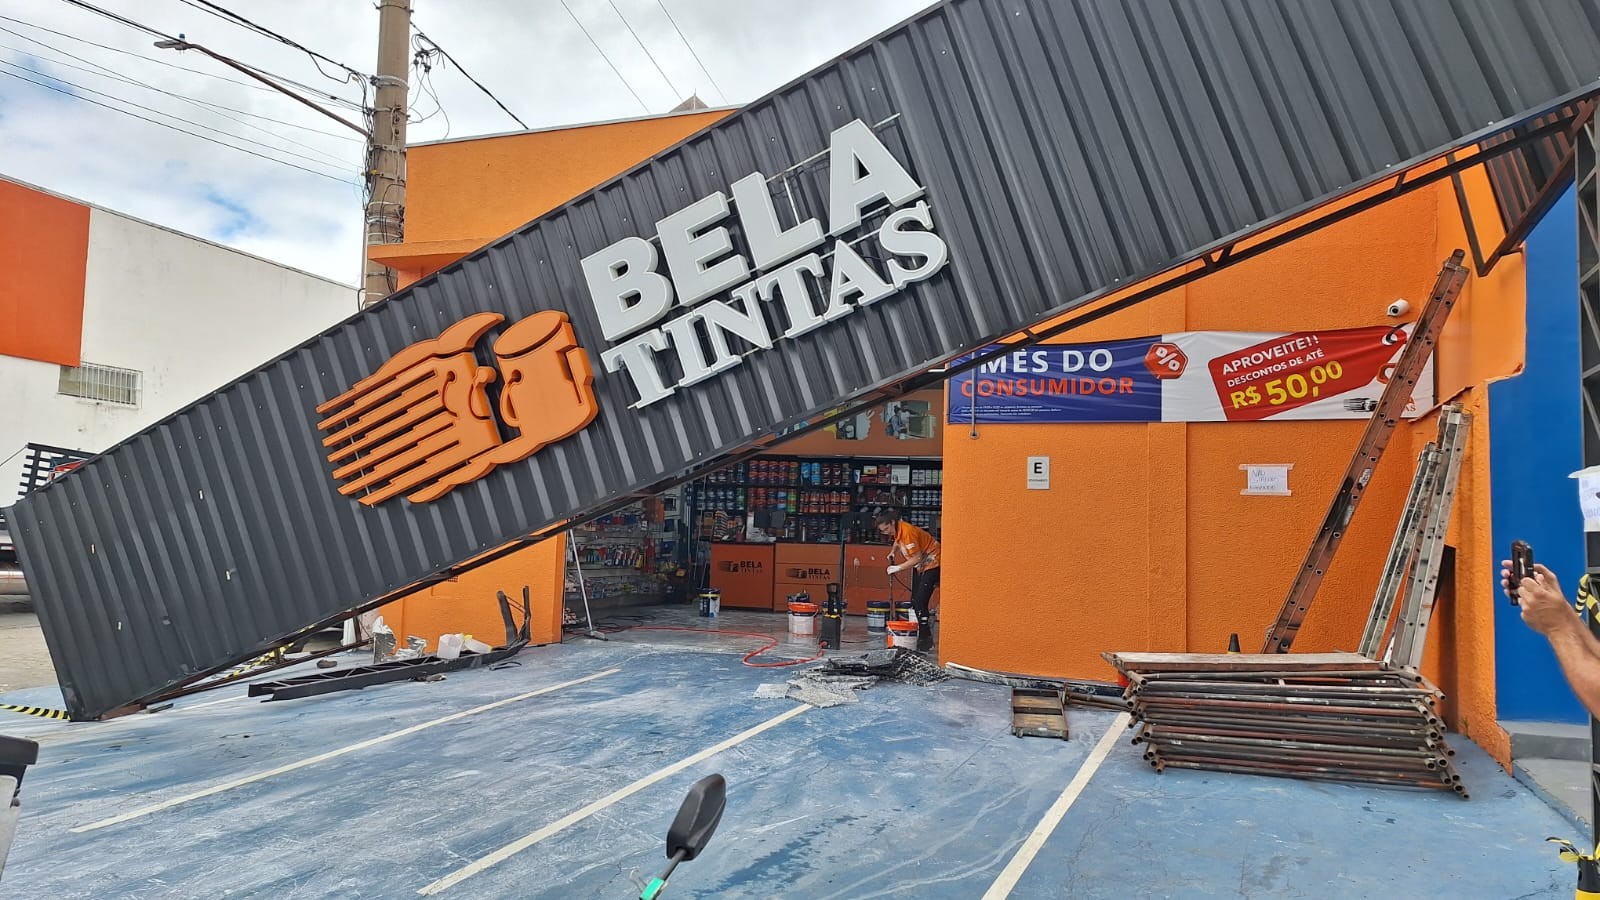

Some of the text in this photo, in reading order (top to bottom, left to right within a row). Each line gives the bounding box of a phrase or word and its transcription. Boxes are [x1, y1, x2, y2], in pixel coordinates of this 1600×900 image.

[581, 118, 923, 341] BELA
[601, 200, 947, 408] TINTAS
[980, 348, 1113, 374] MÊS DO
[1222, 335, 1320, 375] APROVEITE!!
[1227, 349, 1325, 388] DESCONTOS DE ATÉ
[961, 377, 1134, 397] CONSUMIDOR
[1230, 361, 1343, 409] R$ 50,00
[1034, 462, 1043, 474] E
[740, 560, 763, 568] BELA
